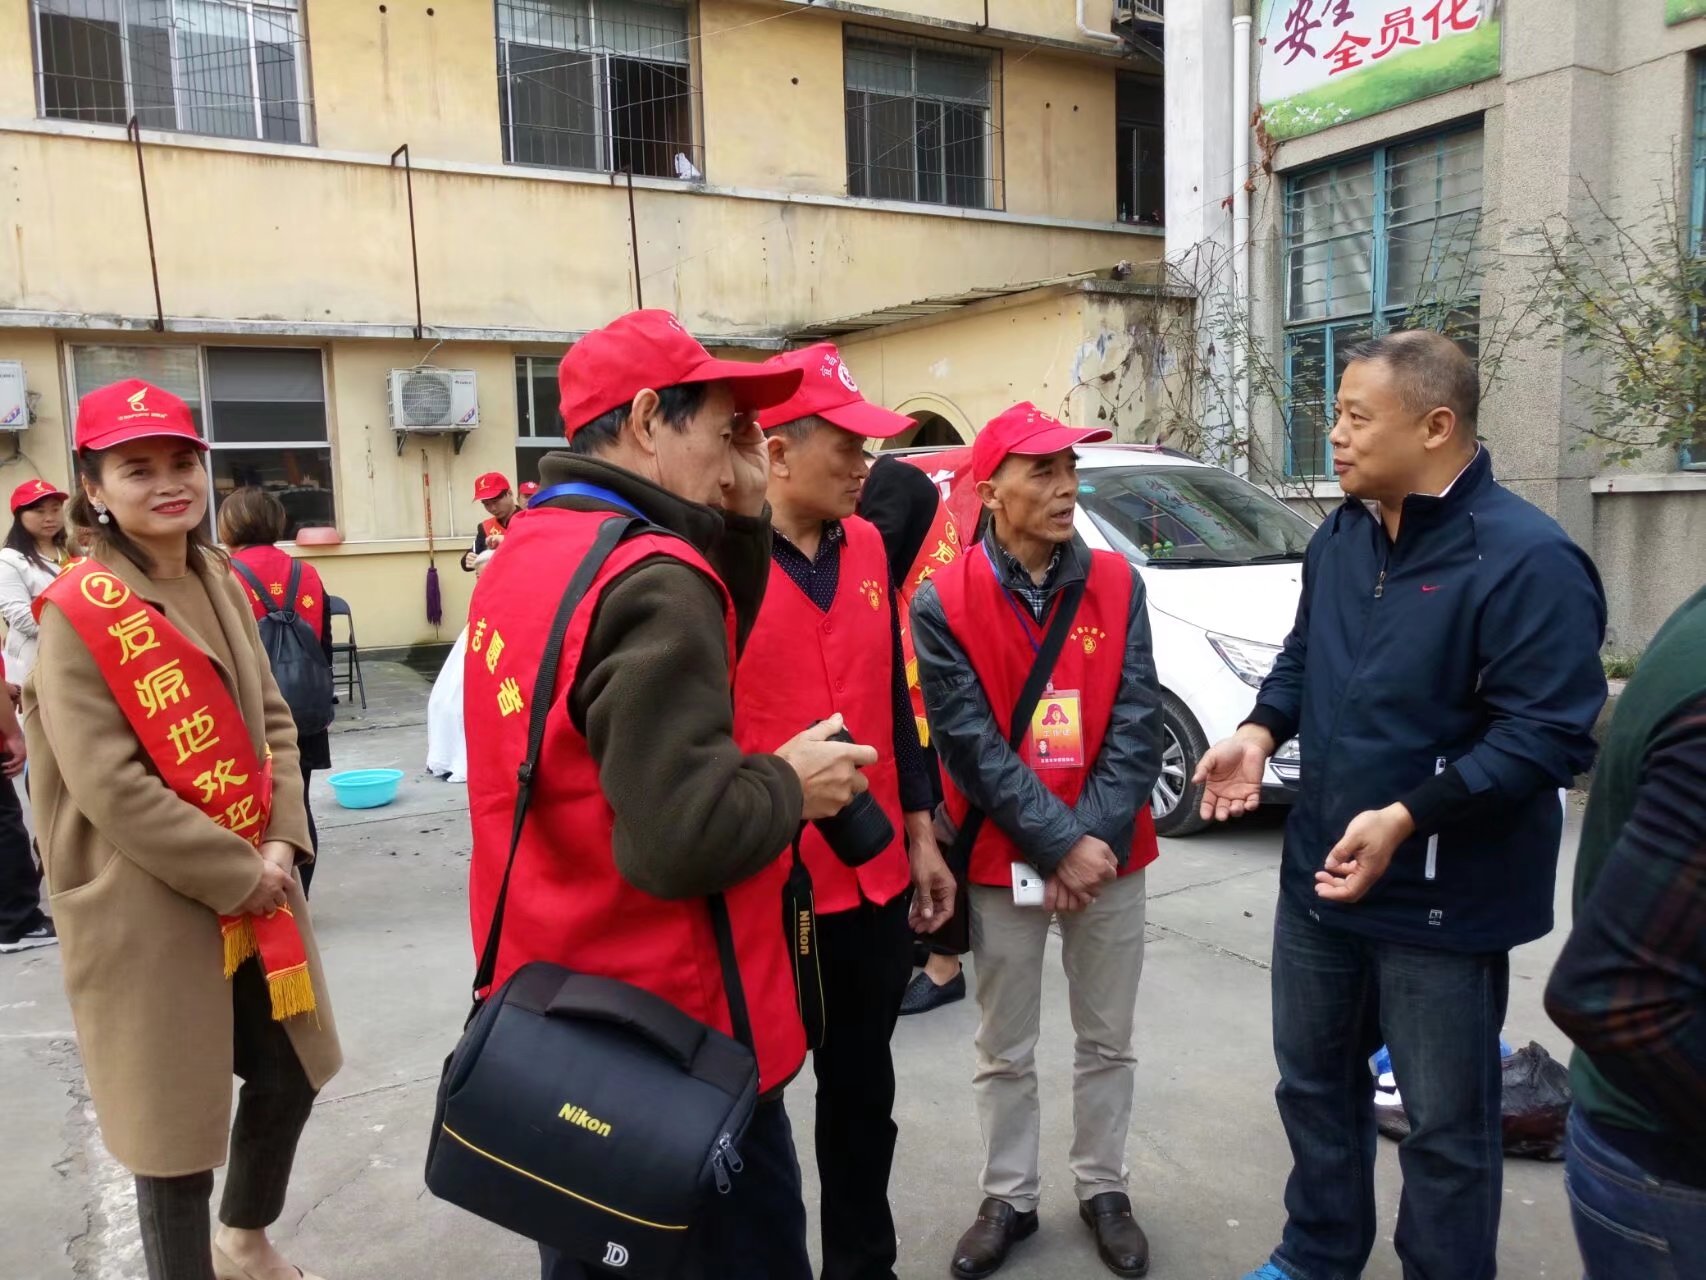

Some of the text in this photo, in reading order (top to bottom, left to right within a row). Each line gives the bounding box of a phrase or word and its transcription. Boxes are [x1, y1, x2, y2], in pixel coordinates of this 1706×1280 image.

[1322, 0, 1480, 76] 全员化
[107, 609, 262, 847] 发源地欢迎
[800, 910, 811, 955] Nikon
[558, 1103, 612, 1137] Nikon
[602, 1241, 629, 1267] D
